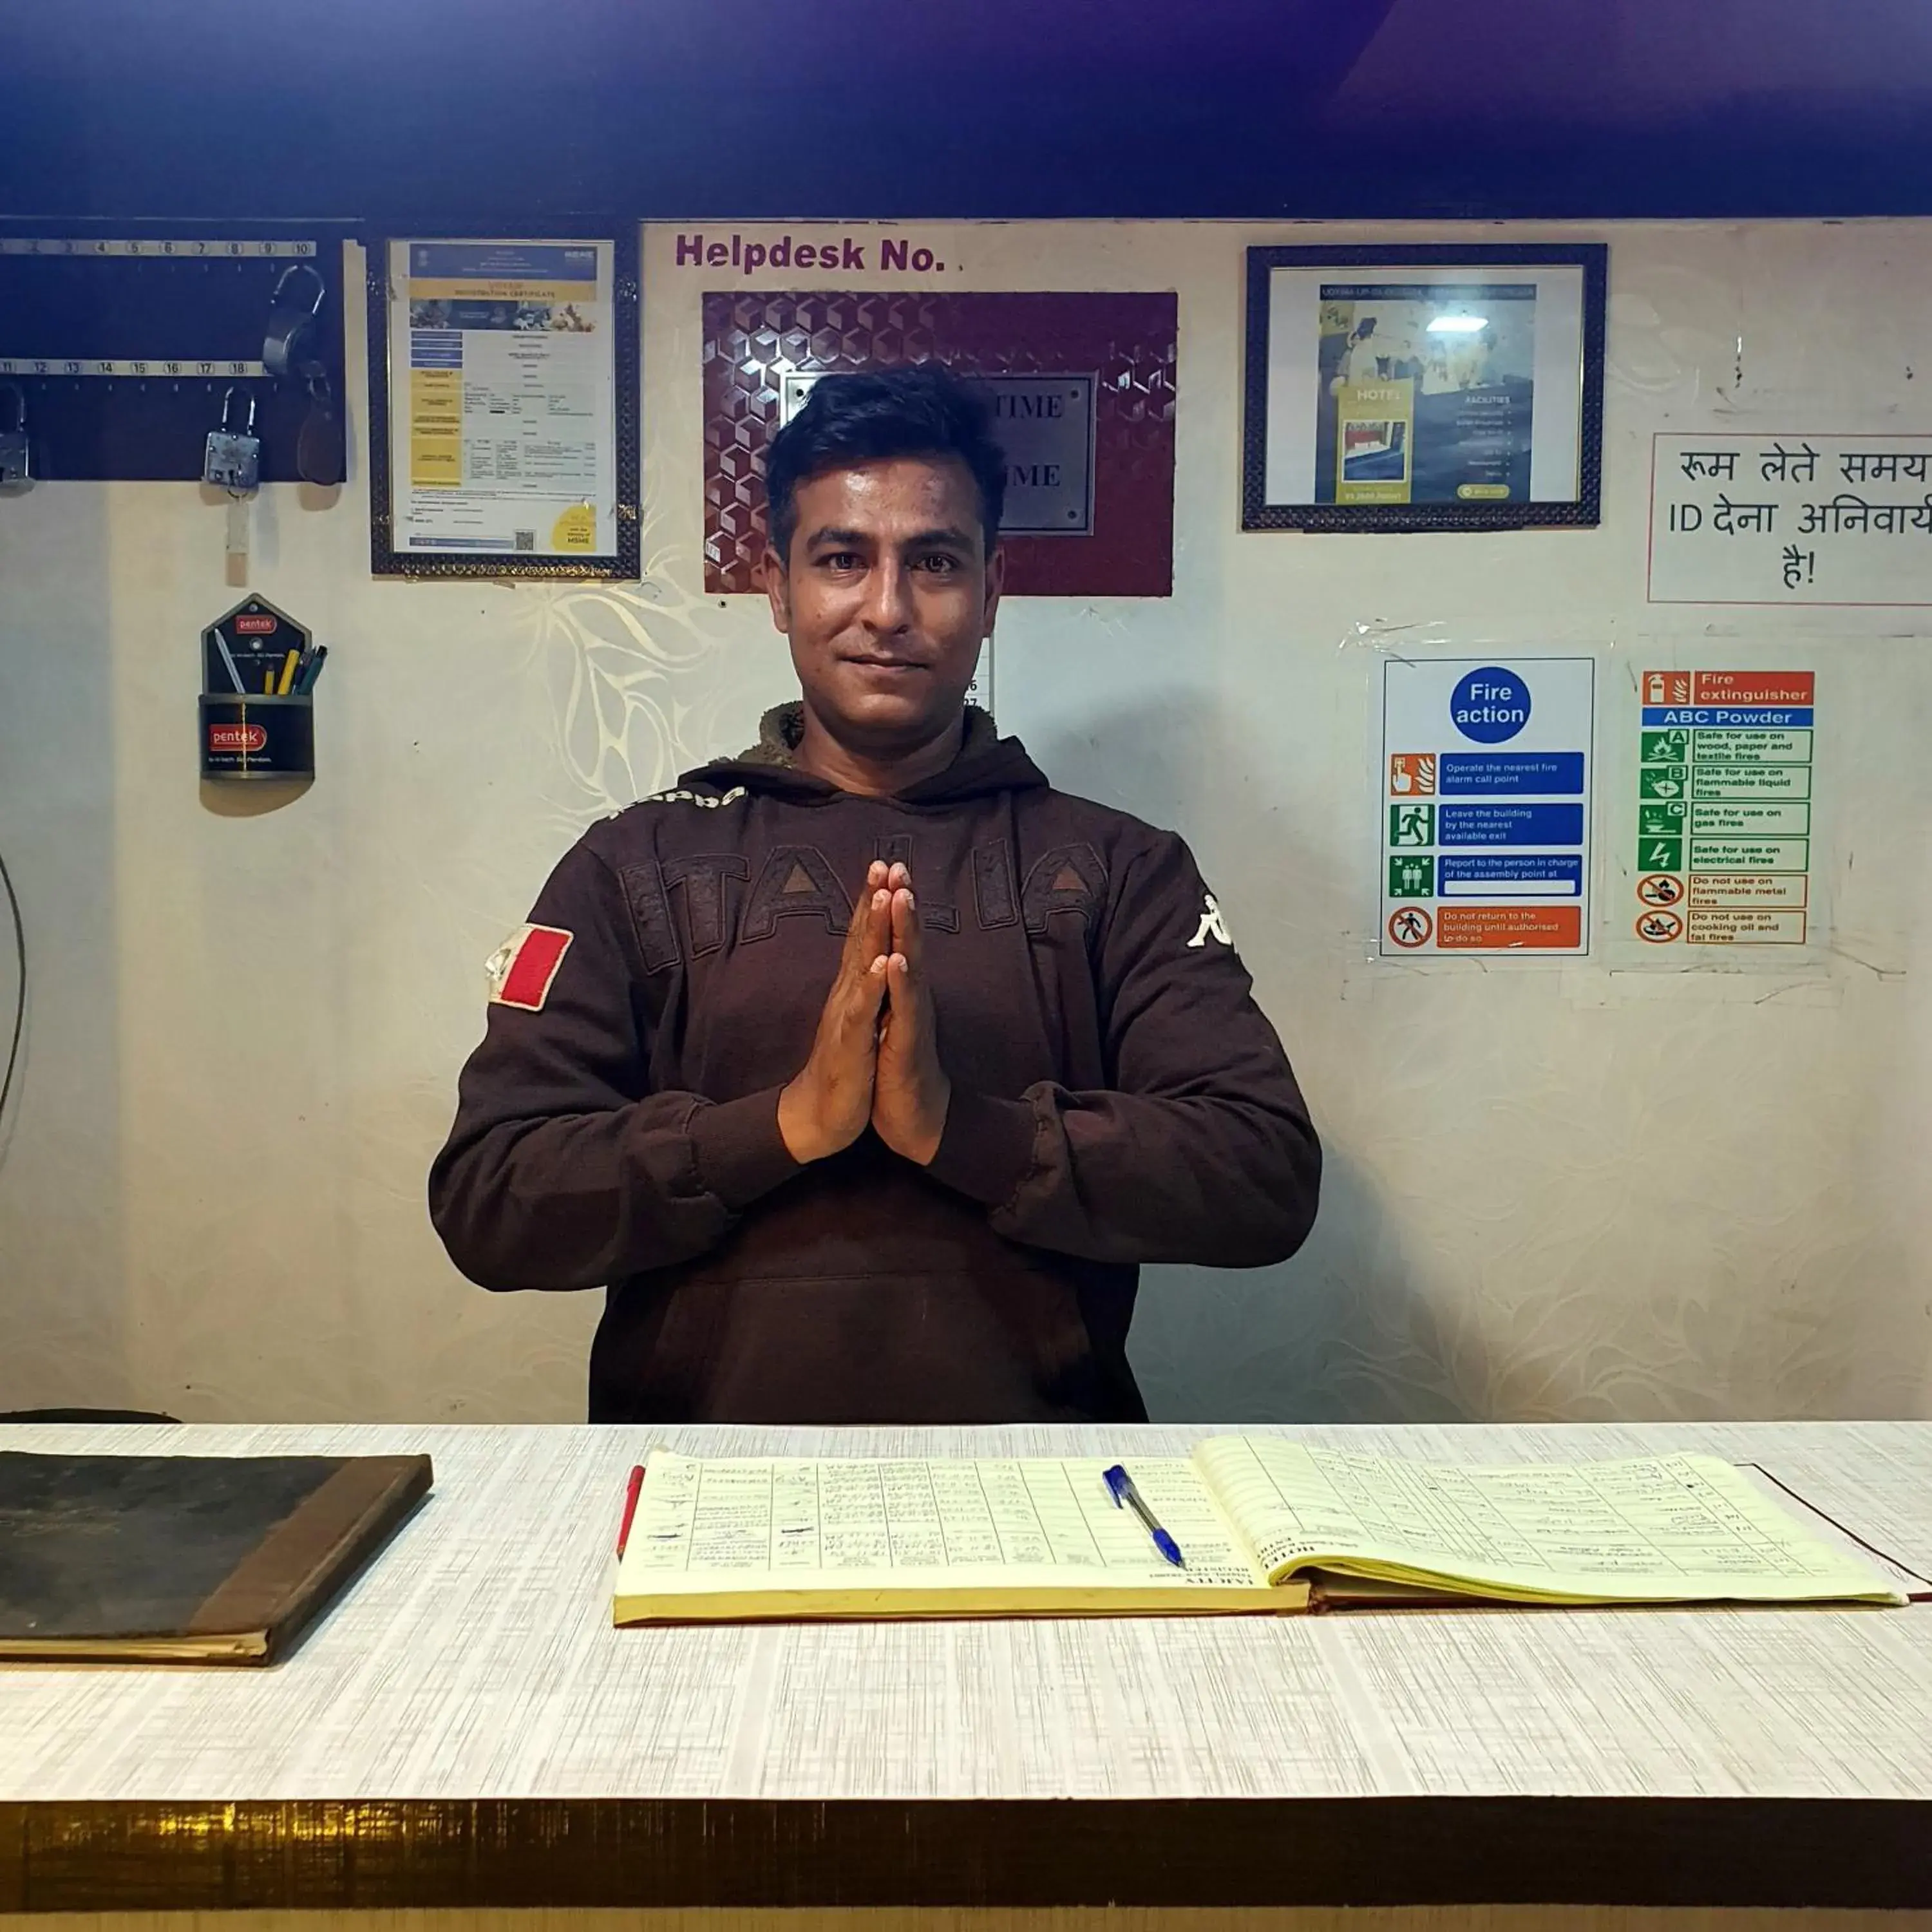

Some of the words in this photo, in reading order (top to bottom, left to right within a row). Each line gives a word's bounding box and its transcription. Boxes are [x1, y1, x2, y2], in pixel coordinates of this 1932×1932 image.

[296, 243, 307, 254] 10
[676, 234, 866, 275] Helpdesk
[880, 239, 945, 272] No.
[100, 363, 113, 373] 14
[134, 363, 145, 373] 15
[167, 363, 178, 373] 16
[201, 363, 212, 373] 17
[233, 363, 244, 373] 18
[1680, 451, 1741, 481] रूम
[1759, 442, 1821, 483] लेते
[1839, 453, 1932, 483] समय
[1670, 504, 1702, 533] ID
[1714, 493, 1779, 535] देना
[1782, 544, 1815, 589] है!
[240, 618, 272, 629] pentek
[1701, 674, 1734, 685] Fire
[1470, 683, 1513, 701] Fire
[1700, 689, 1808, 702] extinguisher
[1456, 705, 1524, 723] action
[1664, 710, 1709, 723] ABC
[1716, 710, 1792, 724] Powder
[213, 731, 258, 743] pentek
[1672, 731, 1685, 743] A
[1446, 764, 1484, 774] Operate
[1486, 763, 1501, 773] the
[1504, 763, 1539, 773] nearest
[1542, 763, 1557, 773] fire
[1673, 766, 1685, 779] B
[1446, 775, 1473, 784] alarm
[1475, 775, 1492, 784] call
[1494, 775, 1519, 786] point
[1759, 779, 1791, 788] liquid
[1446, 810, 1473, 818] Leave
[1476, 810, 1491, 818] the
[1493, 810, 1532, 819] building
[1670, 803, 1683, 815] C
[1445, 821, 1457, 830] by
[1445, 832, 1487, 840] available
[1489, 832, 1506, 840] exit
[1444, 859, 1475, 868] Report
[1504, 860, 1535, 869] person
[1548, 859, 1578, 869] charge
[1474, 870, 1519, 880] assembly
[1521, 870, 1546, 879] point
[1692, 887, 1752, 895] flammable
[1755, 887, 1786, 895] metal
[1444, 912, 1457, 920] Do
[1459, 912, 1475, 920] not
[1478, 912, 1507, 920] return
[1509, 912, 1520, 920] to
[1522, 912, 1537, 920] the
[1443, 923, 1482, 933] building
[1691, 923, 1738, 933] cooking
